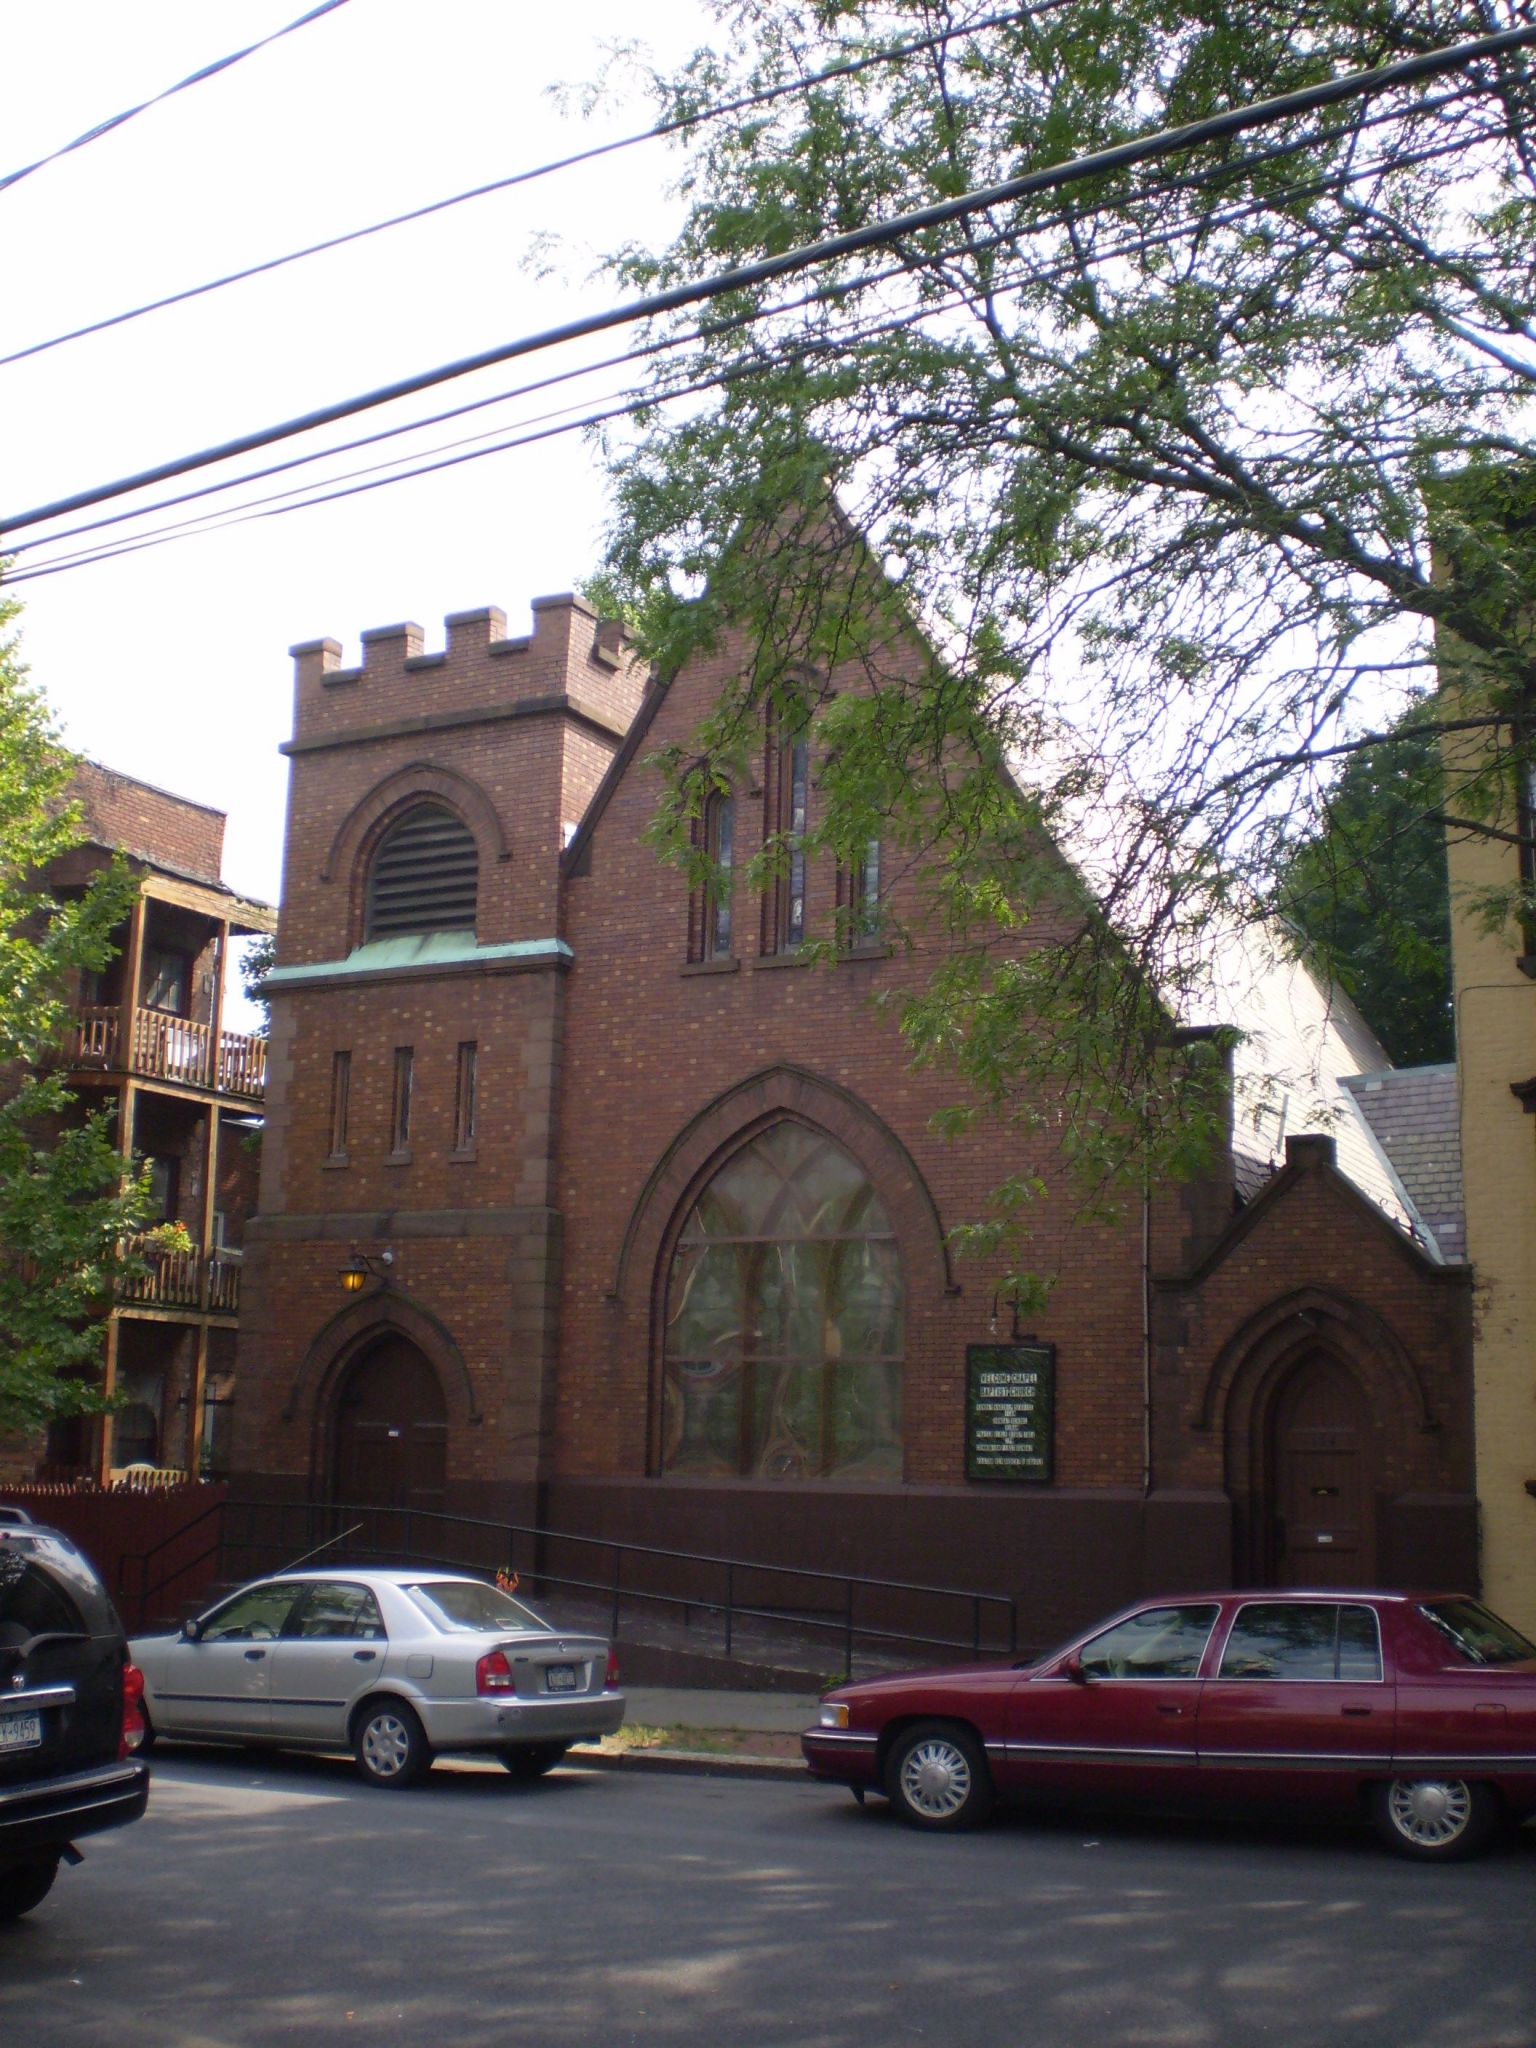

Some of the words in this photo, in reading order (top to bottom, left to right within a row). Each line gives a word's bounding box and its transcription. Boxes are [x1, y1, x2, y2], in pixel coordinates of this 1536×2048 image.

[980, 1373, 1010, 1384] WELCOME
[1011, 1373, 1037, 1384] CHAPEL
[980, 1386, 1008, 1397] BAPTIST
[1010, 1386, 1035, 1397] CHURCH
